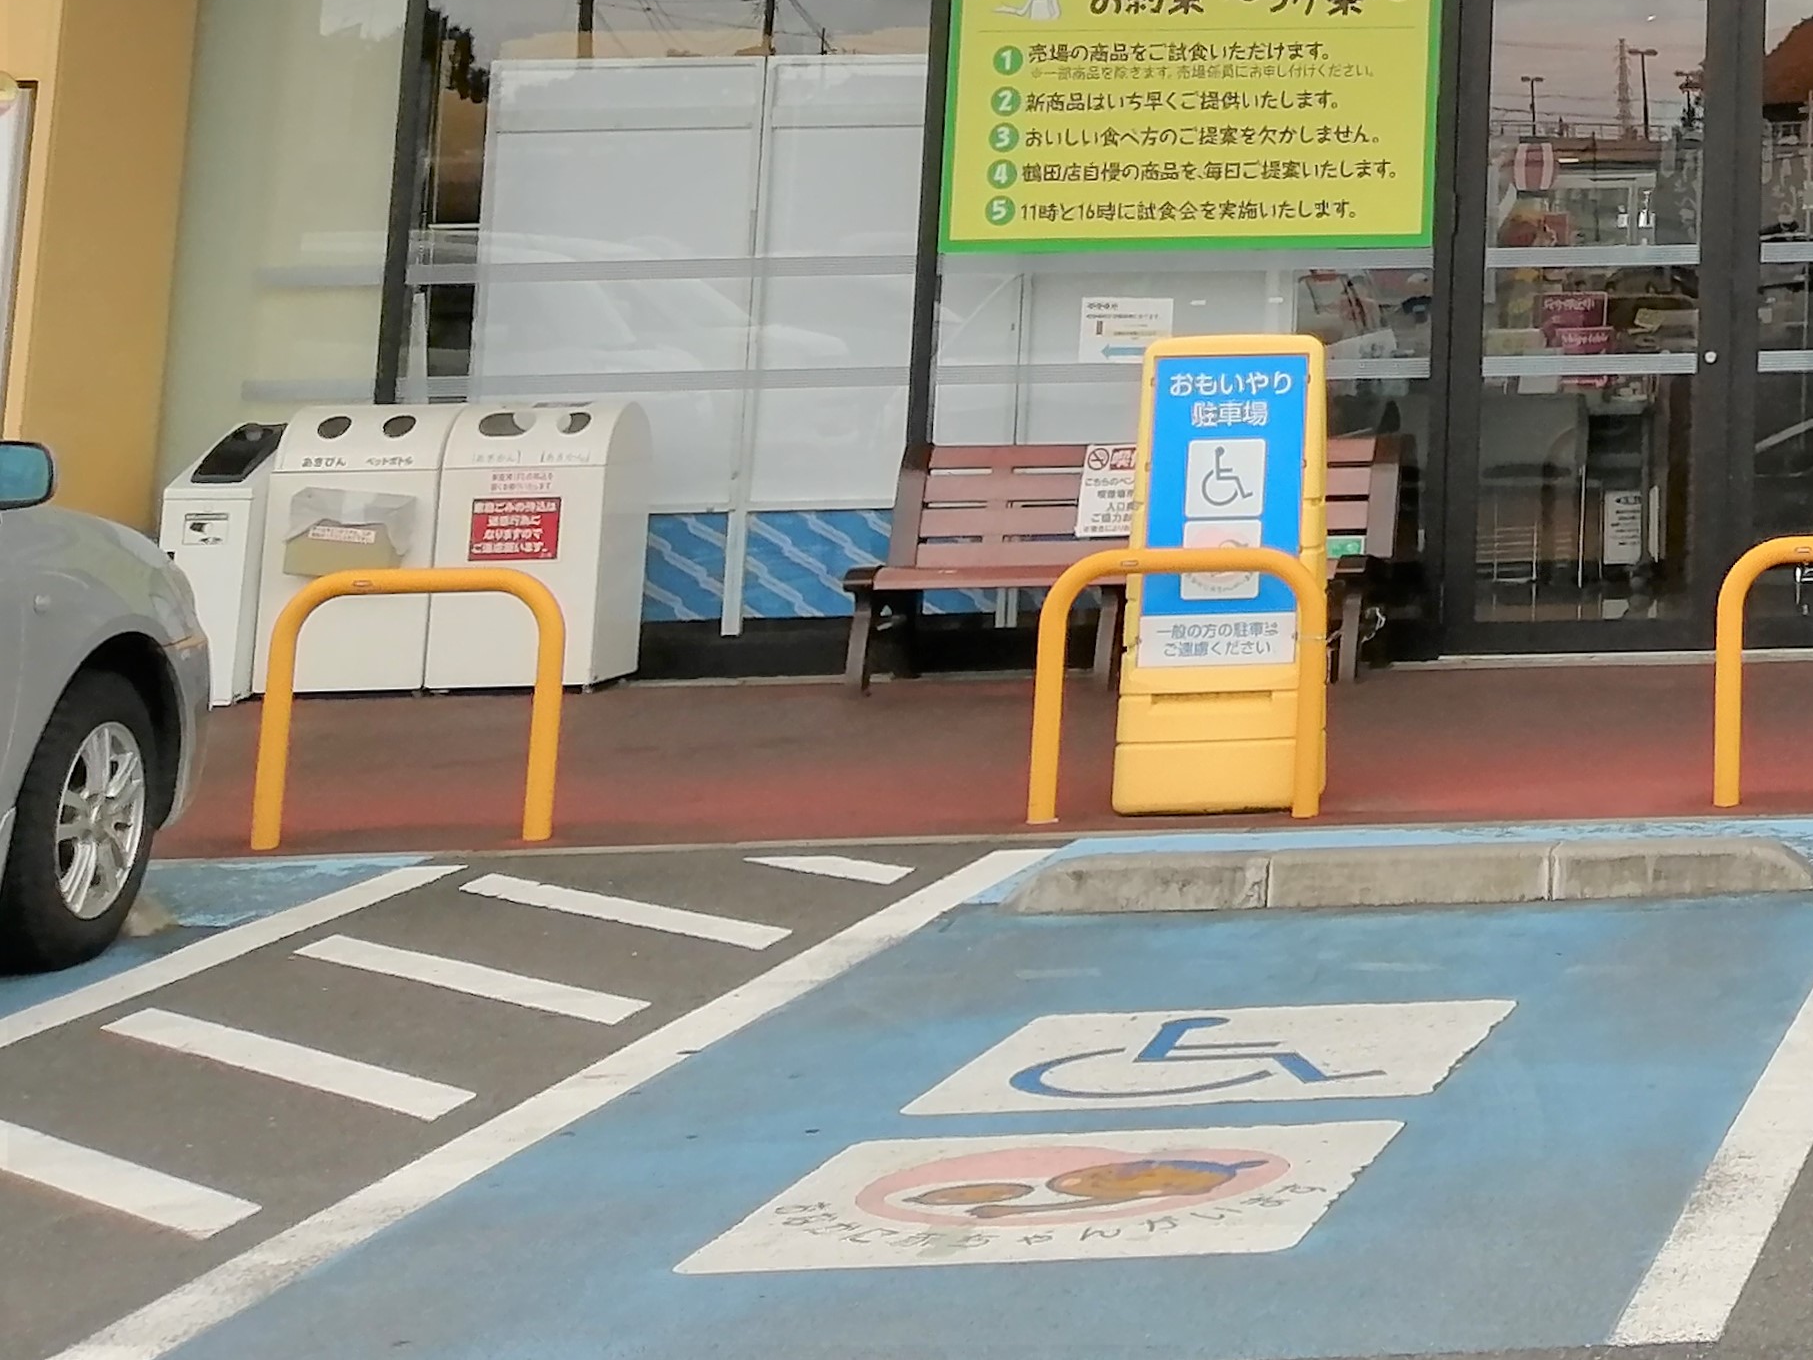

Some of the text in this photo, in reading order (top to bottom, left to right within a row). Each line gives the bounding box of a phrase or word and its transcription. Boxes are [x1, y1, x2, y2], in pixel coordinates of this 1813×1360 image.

[1028, 41, 1330, 64] 売場の商品をご試食いただけます。
[1025, 89, 1339, 113] 新商品はいち早くご提供いたします。
[1025, 124, 1380, 148] おいしい食べ方のご提案を欠かしません。
[1022, 159, 1398, 183] 鶴田店自慢の商品を、毎日ご提案いたします。
[1021, 198, 1357, 222] 11時と16時に試食会を実施いたします。
[1169, 370, 1292, 397] おもいやり
[1190, 400, 1269, 428] 駐車場
[1156, 621, 1279, 640] 一般の方の駐車は
[1163, 640, 1272, 658] ご遠慮ください
[774, 1182, 1332, 1247] おなかに赤ちゃんがいます
